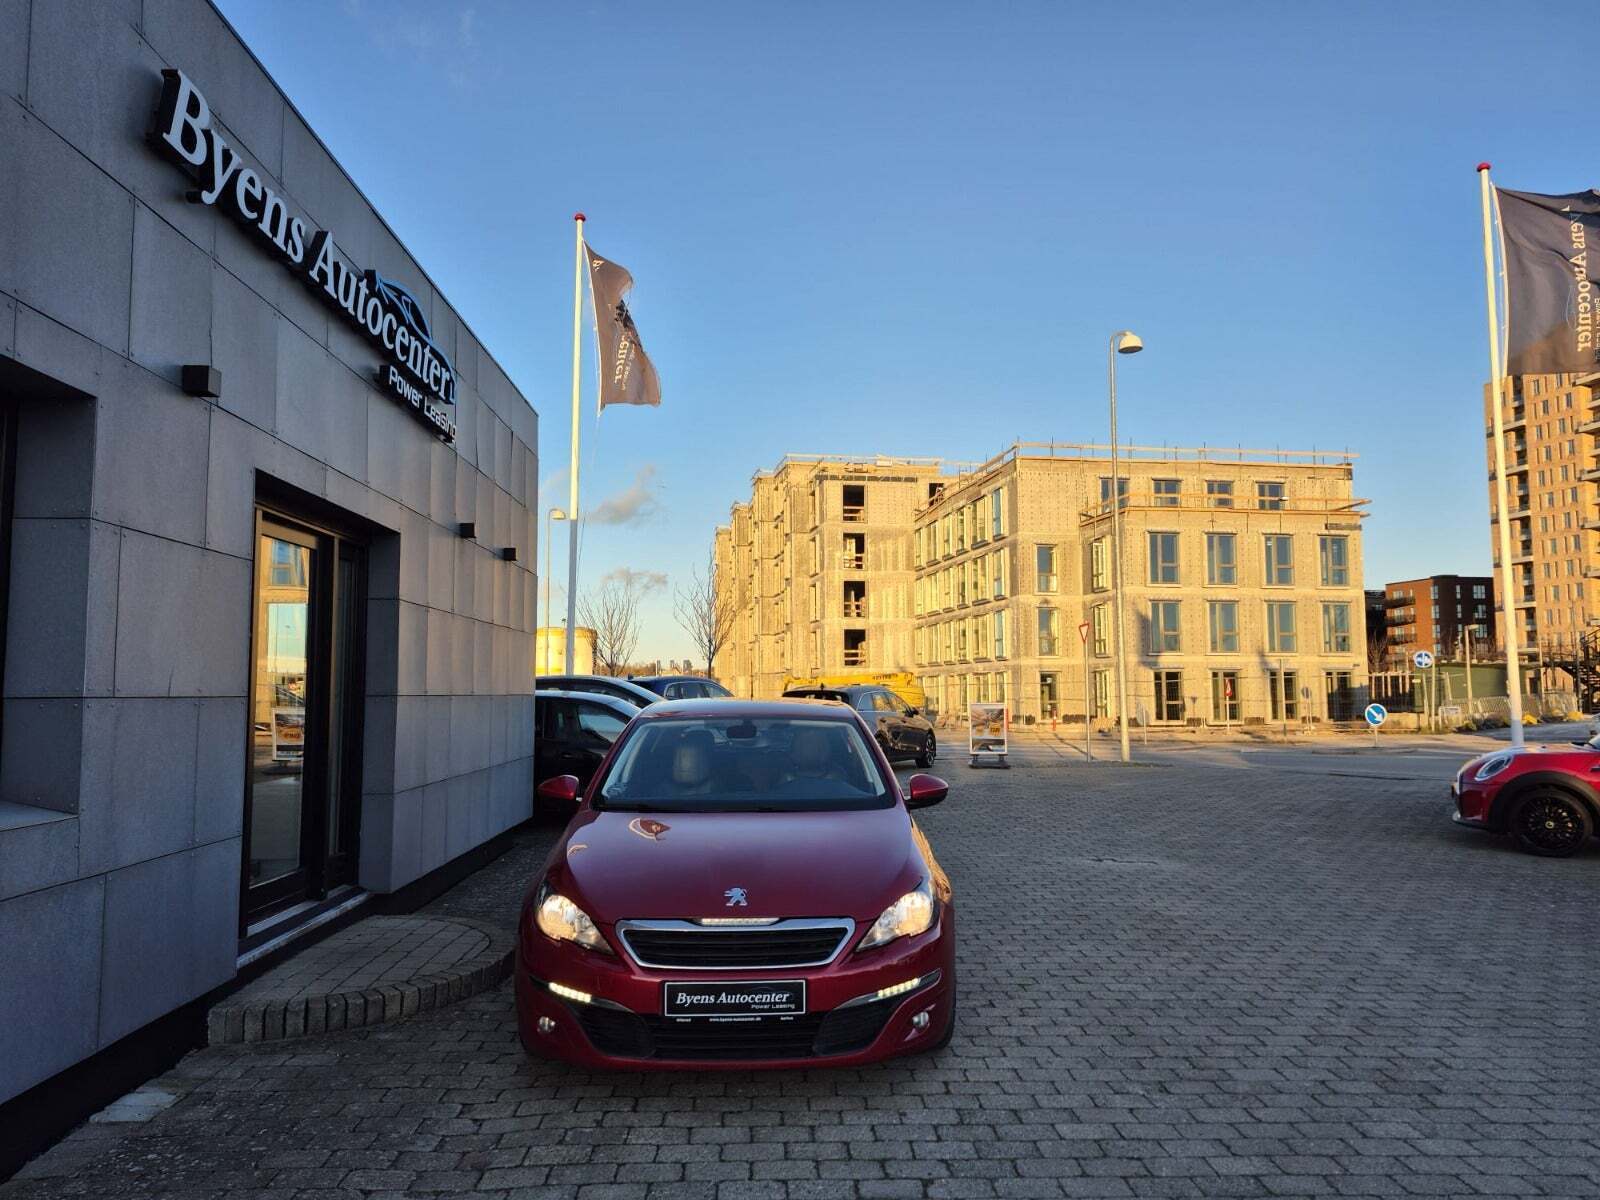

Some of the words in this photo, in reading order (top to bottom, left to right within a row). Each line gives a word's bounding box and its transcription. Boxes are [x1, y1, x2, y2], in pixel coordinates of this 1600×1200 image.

[162, 69, 307, 264] Byens
[309, 230, 450, 401] Autocenter
[389, 365, 422, 409] Power
[424, 396, 456, 444] Leasing
[675, 992, 715, 1007] Byens
[716, 992, 790, 1004] Autocenter
